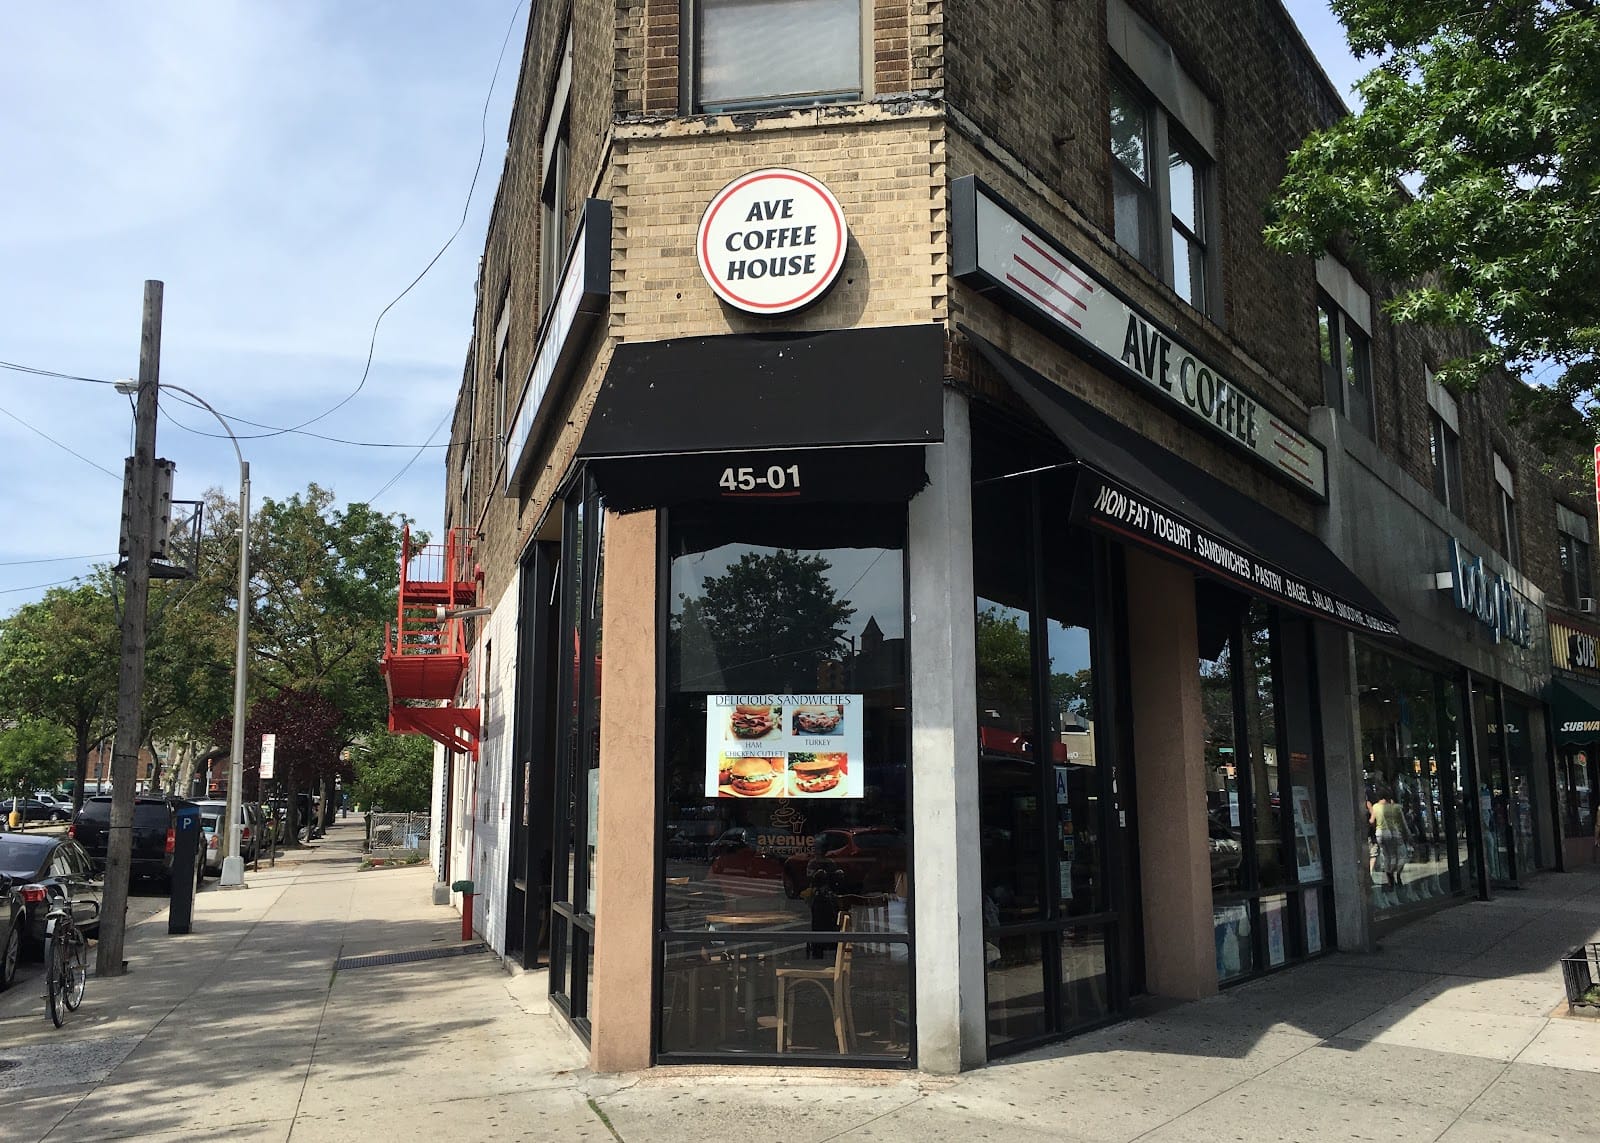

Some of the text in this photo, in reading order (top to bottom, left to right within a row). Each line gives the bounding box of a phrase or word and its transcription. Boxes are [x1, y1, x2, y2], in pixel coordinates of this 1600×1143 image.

[745, 198, 794, 222] AVE
[725, 225, 817, 252] COFFEE
[726, 254, 816, 281] HOUSE
[1121, 313, 1257, 448] AVE COFFEE
[719, 465, 801, 491] 45-01
[1093, 485, 1128, 520] NON
[1125, 499, 1151, 531] FAT
[1152, 510, 1192, 550] YOGURT
[1197, 534, 1251, 579] SANDWICHES
[1254, 563, 1283, 594] PASTRY
[1286, 578, 1311, 605] BAGEL
[1312, 590, 1335, 614] SALAD
[1576, 633, 1600, 669] SUB
[715, 695, 851, 705] DELICIOUS SANDWICHES
[1561, 721, 1600, 732] SUBWA
[745, 741, 762, 749] HAM
[805, 738, 831, 746] TURKEY
[1057, 771, 1066, 794] A
[182, 817, 192, 829] P
[757, 834, 816, 846] avenue
